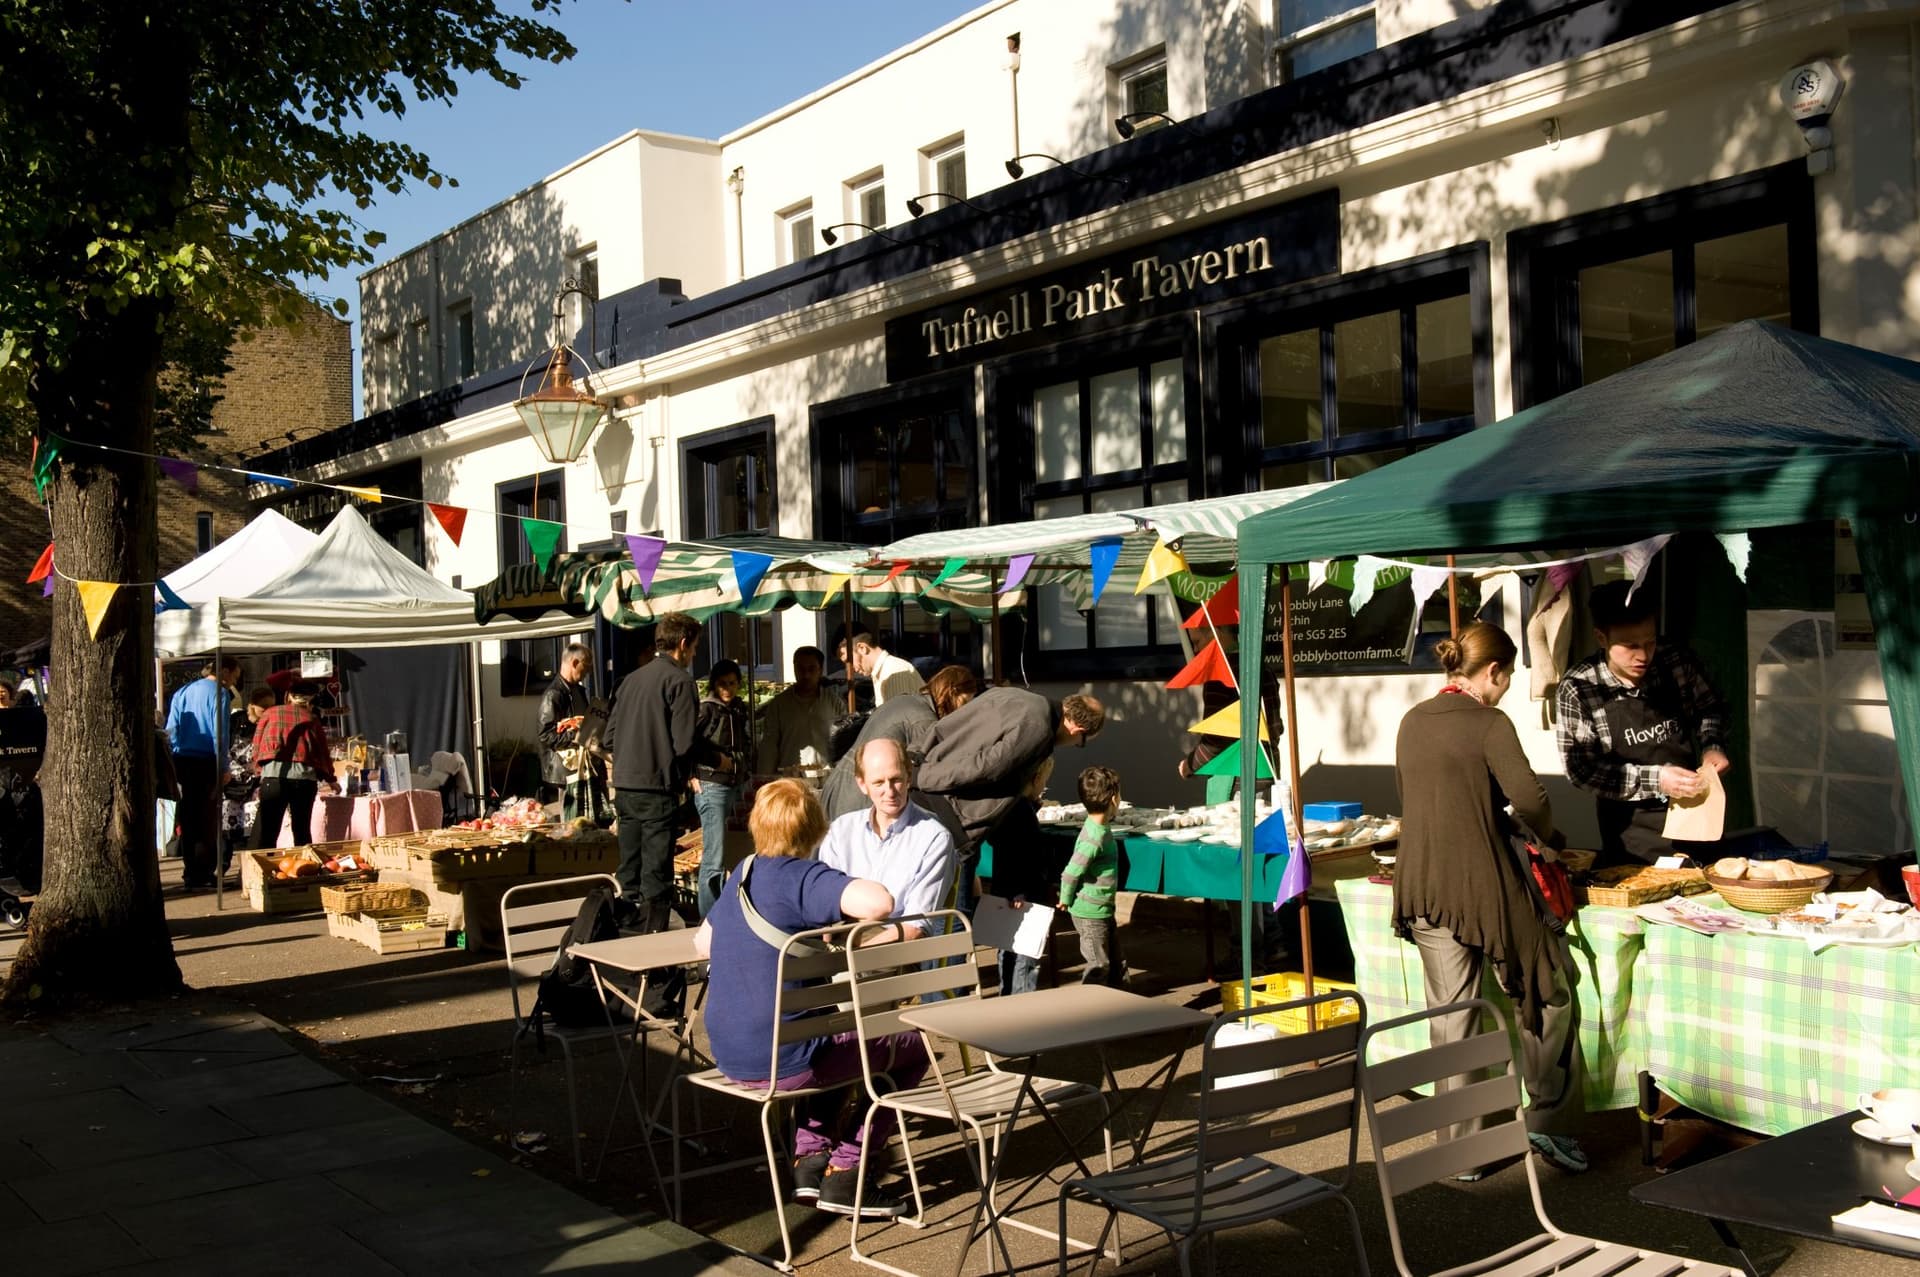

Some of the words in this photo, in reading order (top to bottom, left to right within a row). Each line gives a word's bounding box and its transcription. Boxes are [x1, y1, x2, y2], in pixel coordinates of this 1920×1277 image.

[922, 290, 1031, 358] Tufnell
[1042, 268, 1125, 328] Park
[1132, 236, 1275, 302] Tavern
[1320, 597, 1344, 609] Lane
[1306, 628, 1327, 641] SG5
[1327, 627, 1347, 640] 2ES
[6, 746, 38, 755] Tavern
